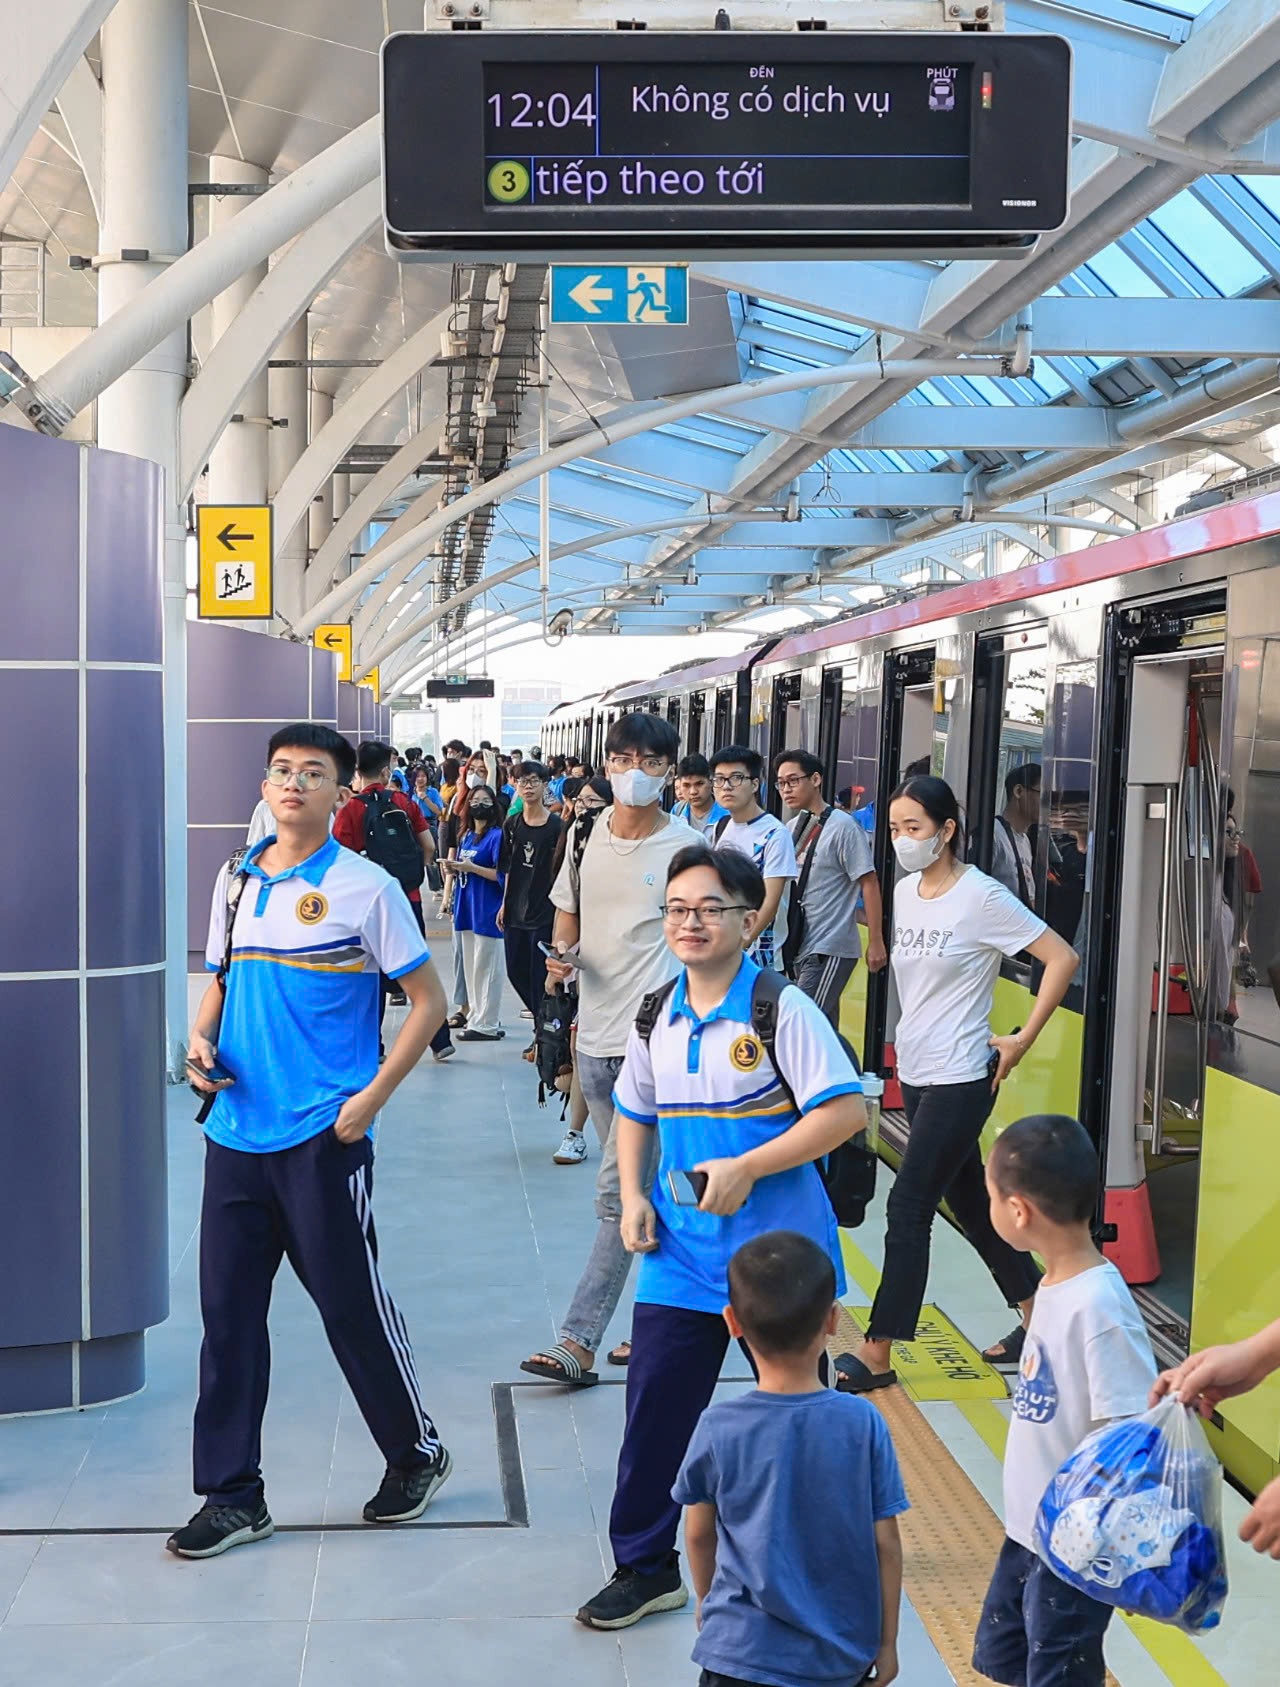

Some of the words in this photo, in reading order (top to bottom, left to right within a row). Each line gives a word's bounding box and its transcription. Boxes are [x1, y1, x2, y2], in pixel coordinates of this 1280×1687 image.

[926, 66, 958, 79] PHÚT
[487, 92, 596, 127] 12:04
[632, 84, 730, 120] Không
[739, 84, 773, 113] có
[783, 85, 846, 118] dịch
[854, 91, 891, 118] vụ
[501, 170, 517, 192] 3
[536, 159, 608, 204] tiếp
[619, 161, 704, 195] theo
[715, 160, 763, 194] tới
[924, 1347, 969, 1365] KHE
